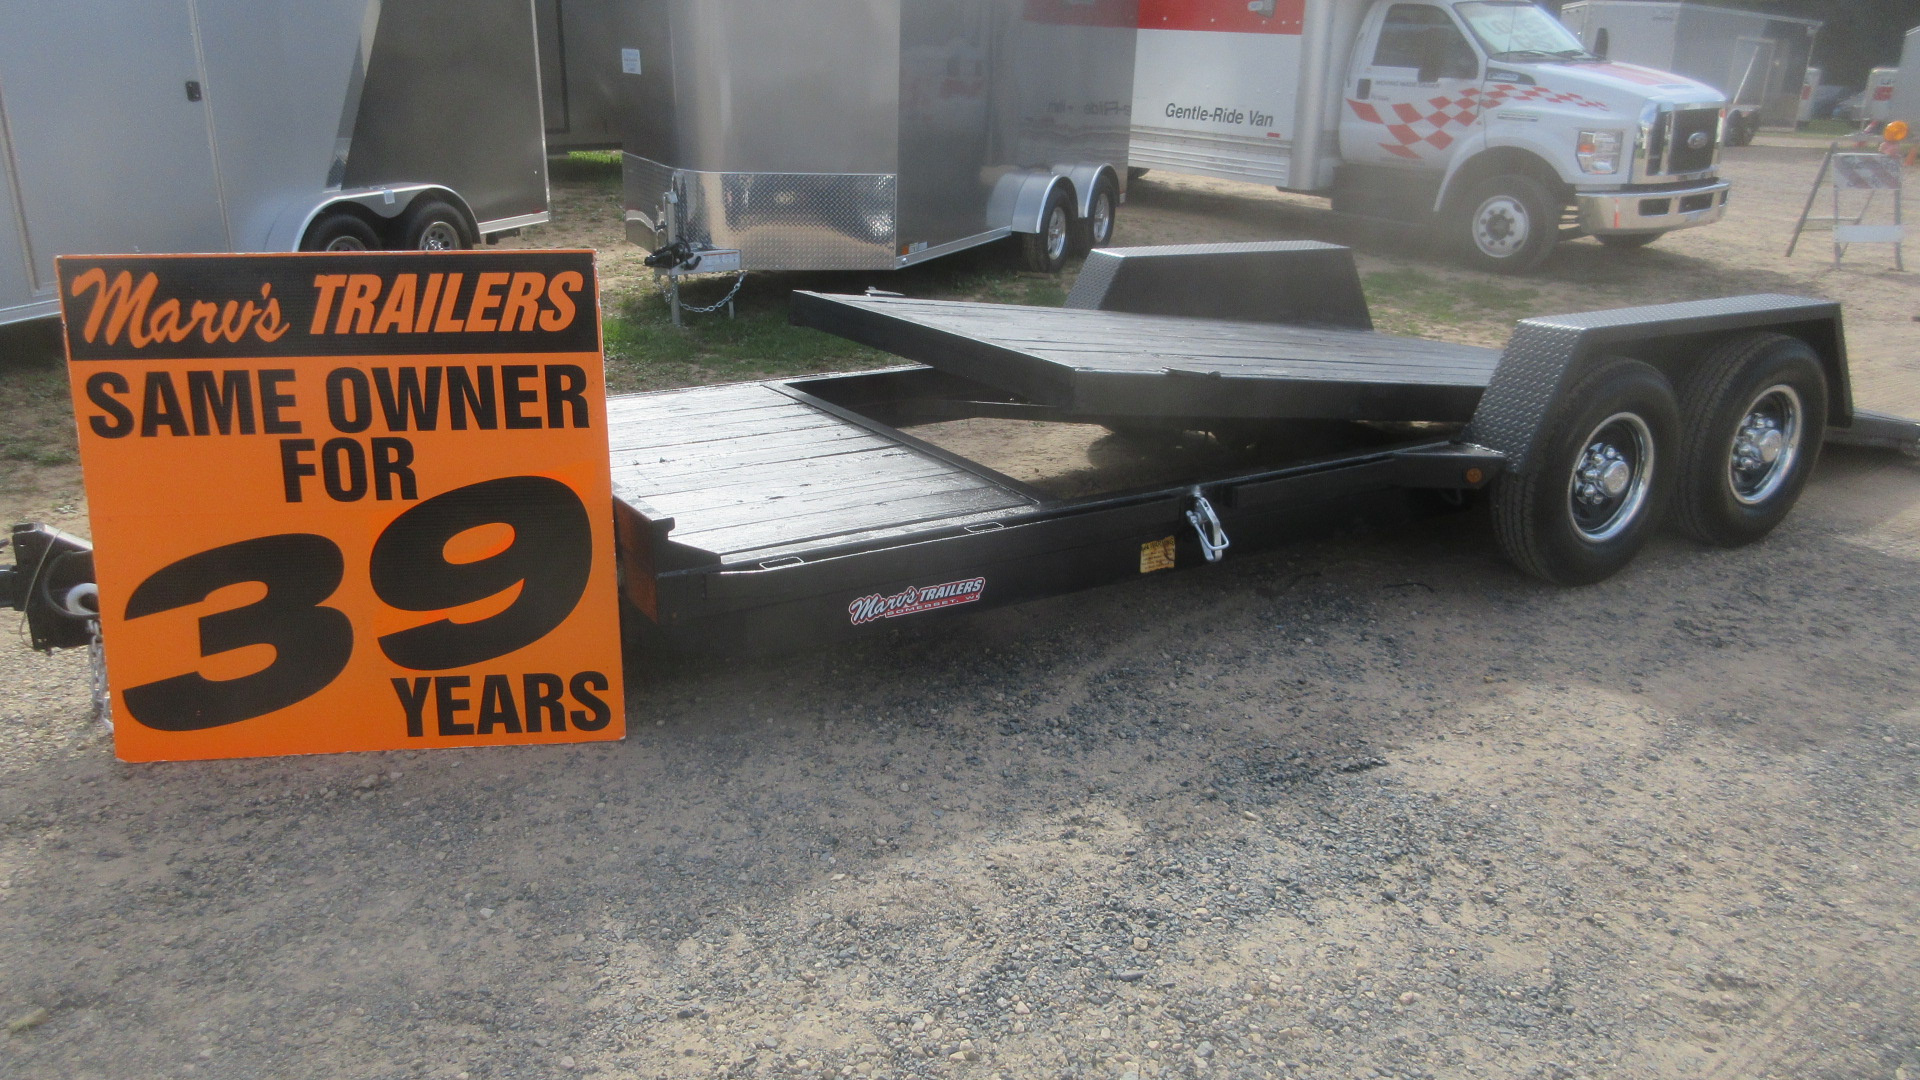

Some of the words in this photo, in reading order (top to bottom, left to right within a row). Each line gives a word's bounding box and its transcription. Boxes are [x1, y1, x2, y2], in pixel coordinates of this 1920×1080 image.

[1165, 103, 1244, 125] Gentle-Ride
[1249, 110, 1274, 128] Van
[71, 267, 290, 349] Marv's
[310, 270, 583, 335] TRAILERS
[86, 368, 303, 438] SAME
[326, 364, 591, 434] OWNER
[280, 436, 418, 503] FOR
[121, 474, 594, 732] 39
[850, 589, 918, 621] Marv's
[919, 579, 983, 602] TRAILERS
[390, 671, 612, 738] YEARS
